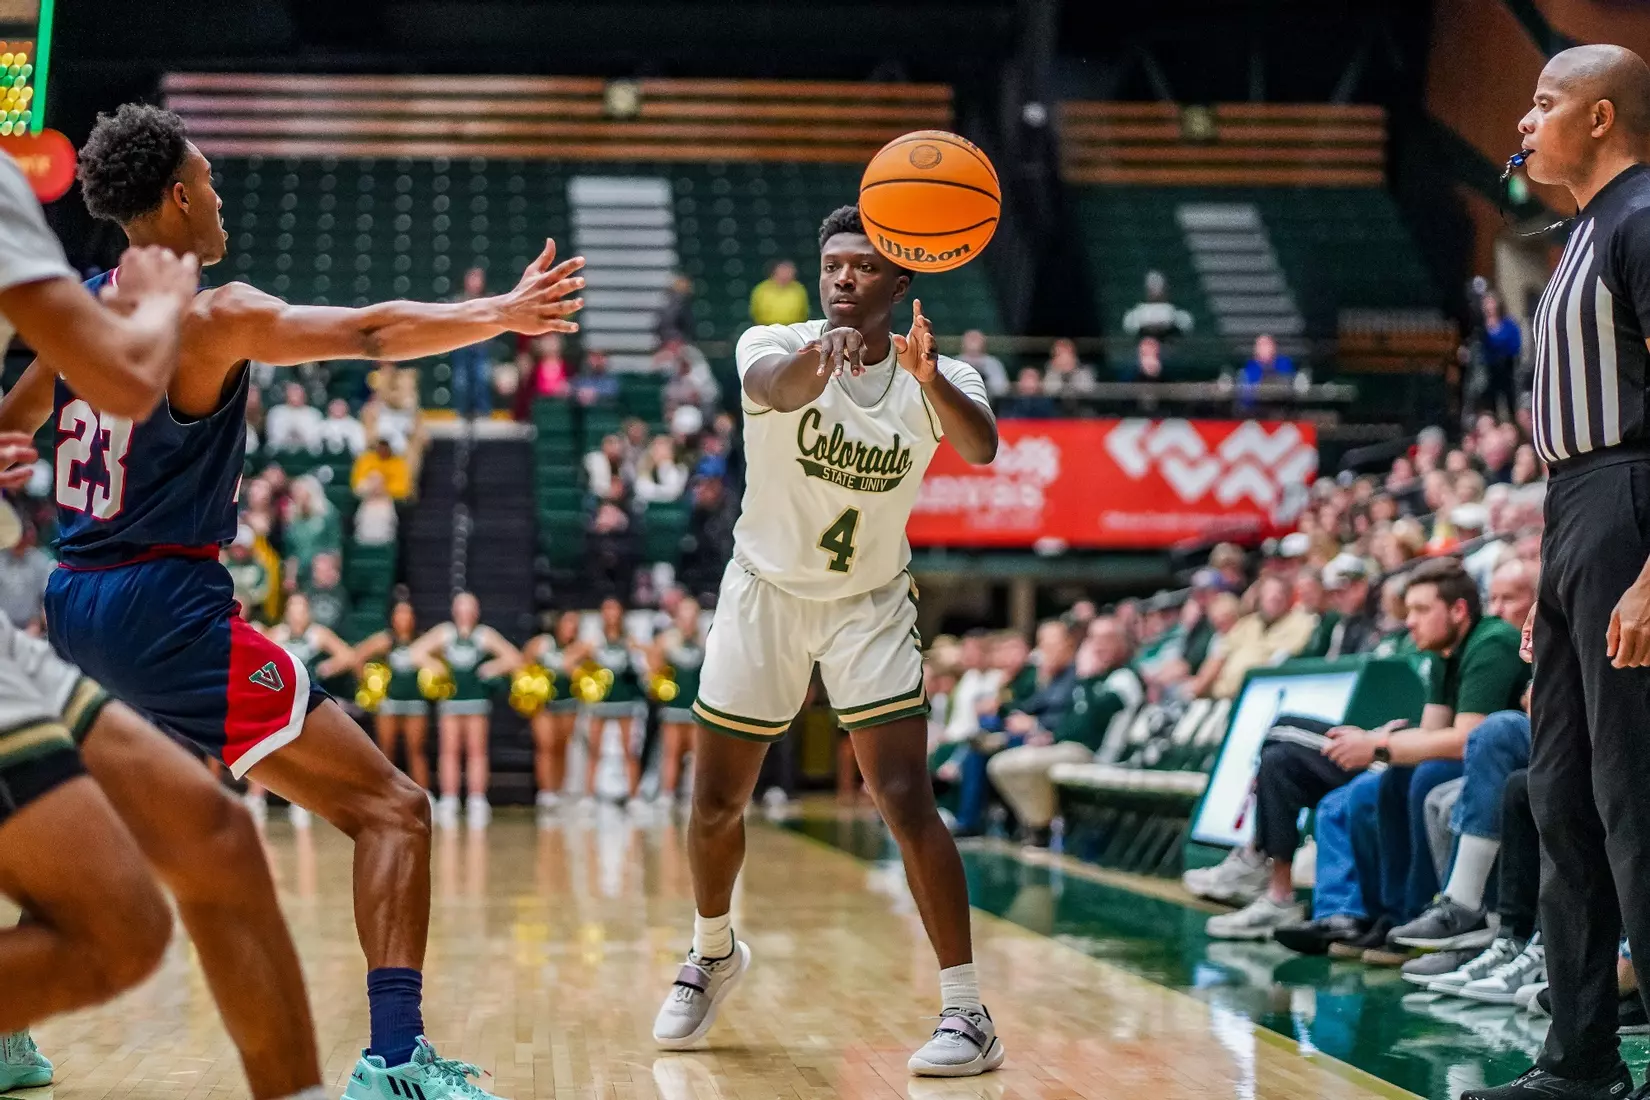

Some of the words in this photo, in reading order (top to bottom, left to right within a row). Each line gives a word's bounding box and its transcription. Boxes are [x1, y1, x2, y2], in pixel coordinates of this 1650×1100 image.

[877, 233, 971, 263] Wilson
[57, 398, 134, 522] 23
[797, 407, 912, 475] Colorado
[822, 466, 857, 489] STATE
[860, 477, 889, 492] UNIV
[816, 504, 862, 576] 4
